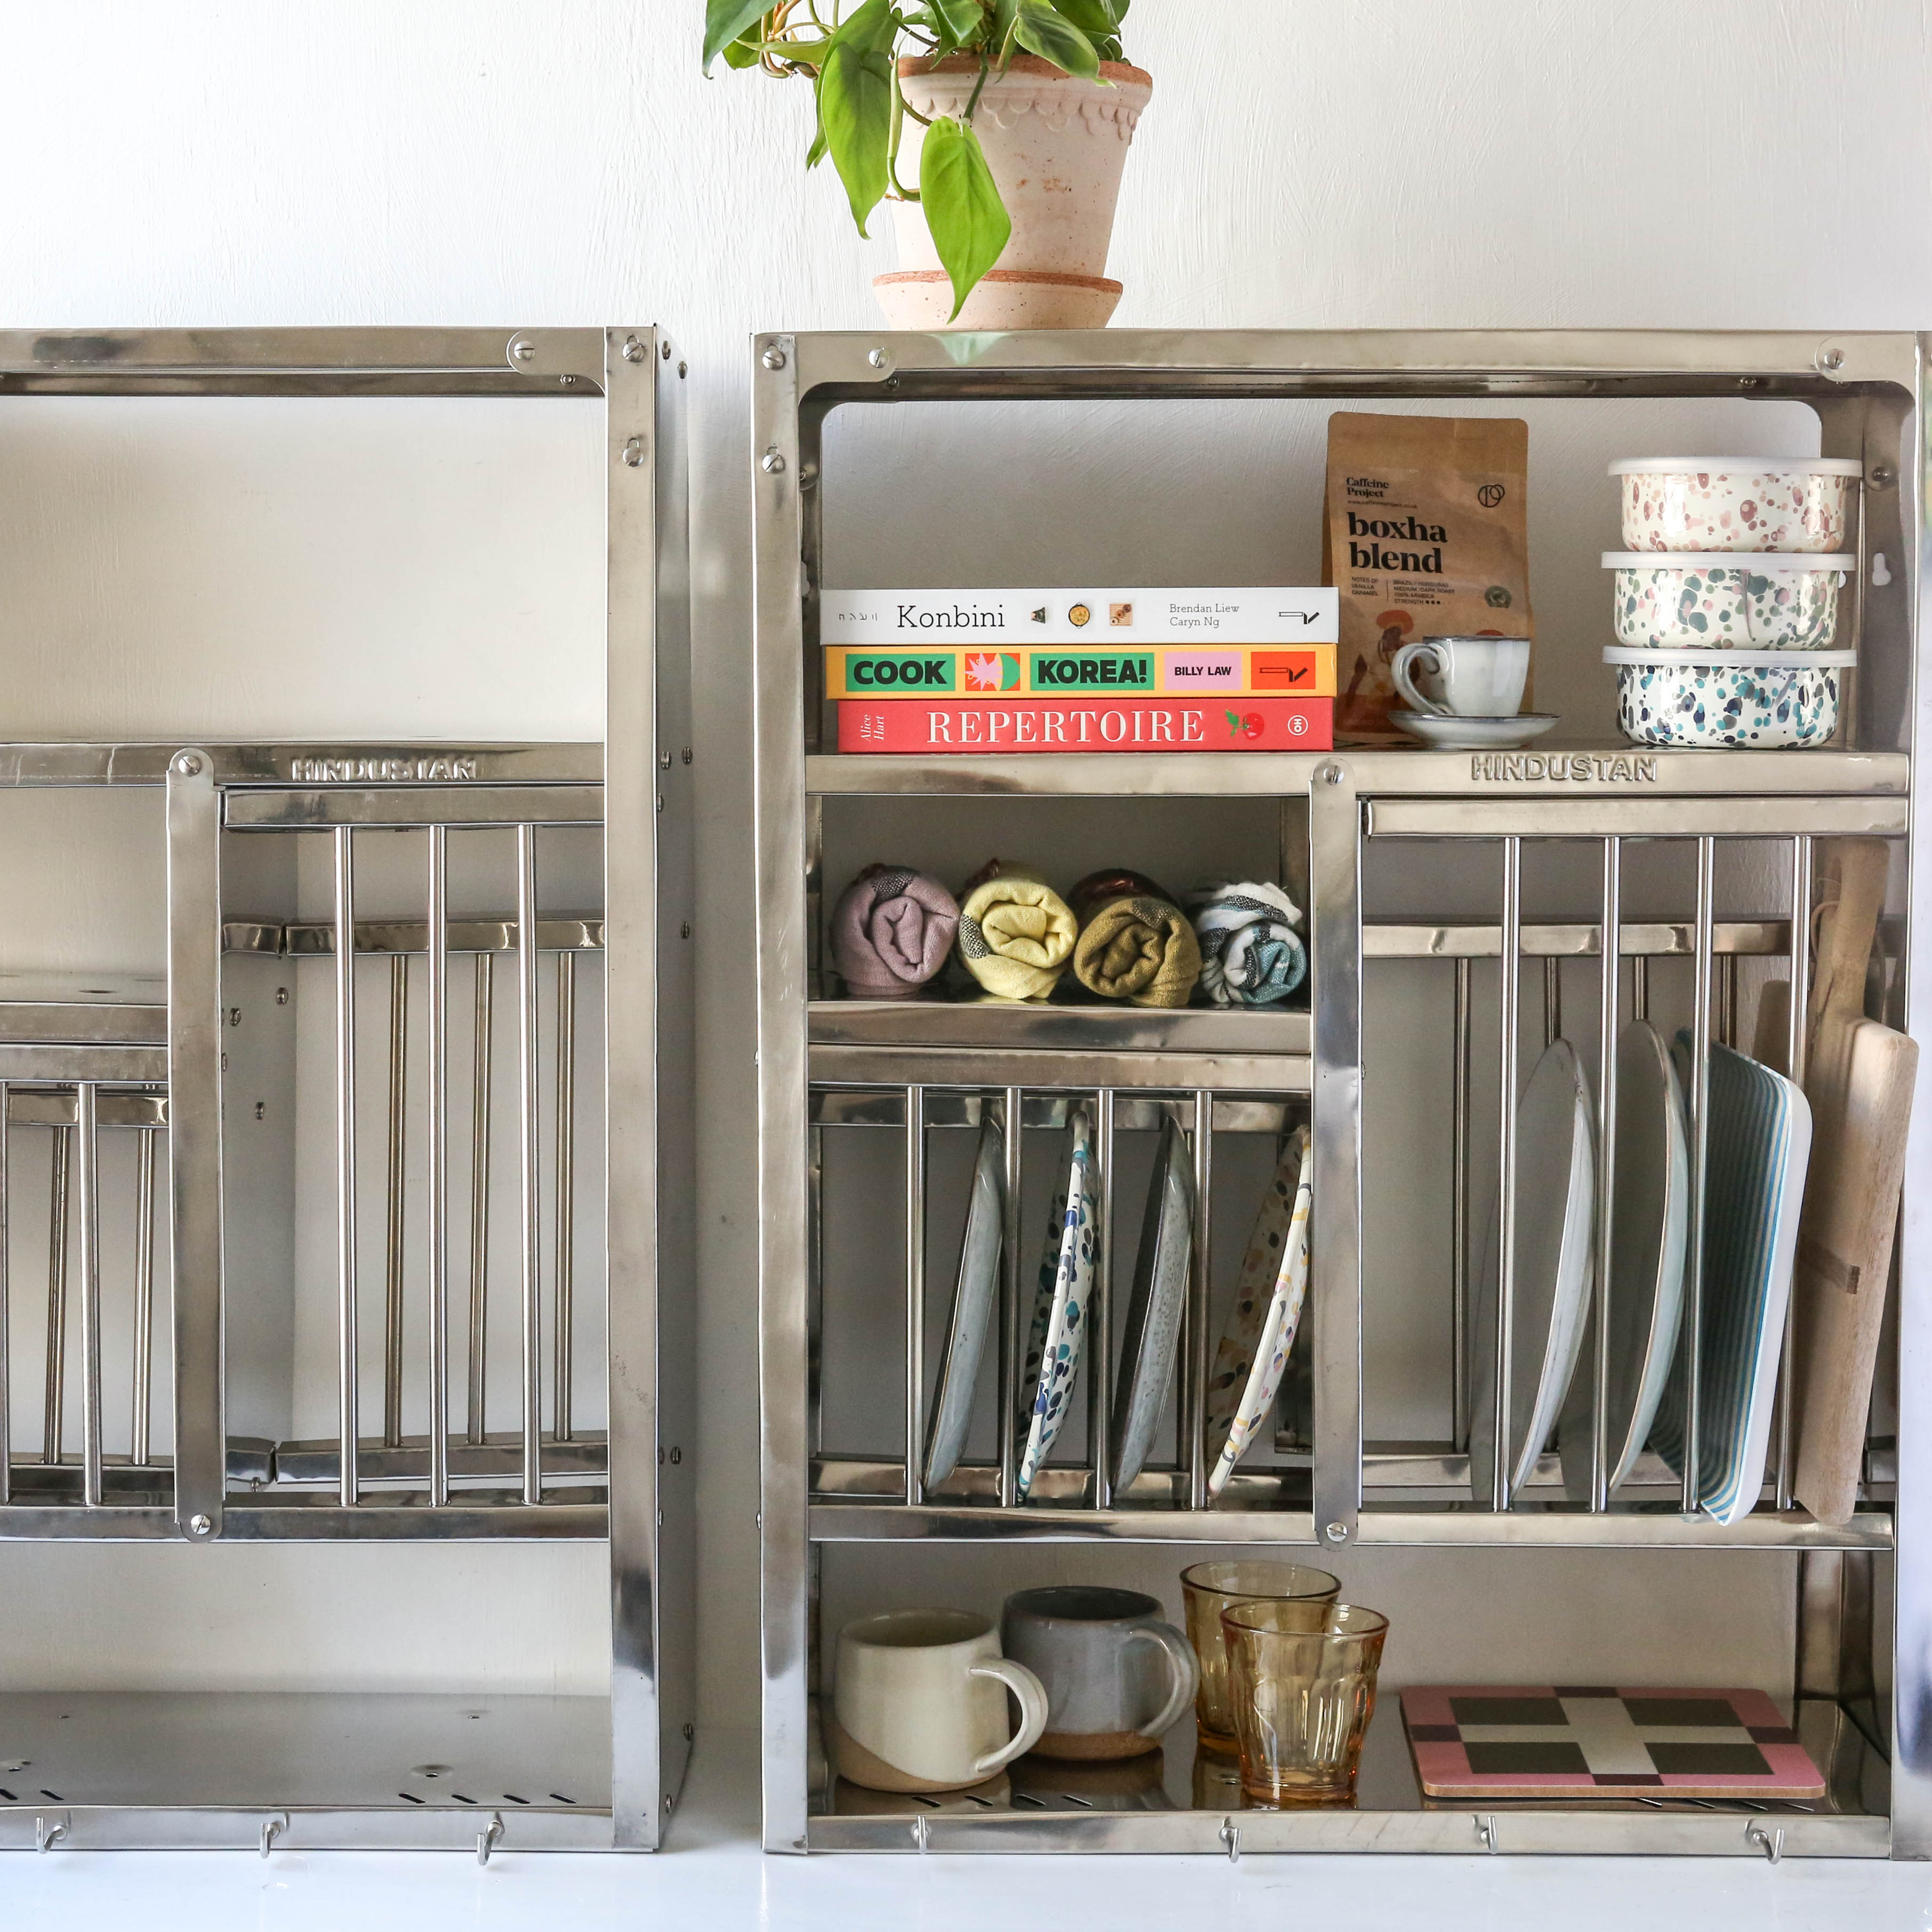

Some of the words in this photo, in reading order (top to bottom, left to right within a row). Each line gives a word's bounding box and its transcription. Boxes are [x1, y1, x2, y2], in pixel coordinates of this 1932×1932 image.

[1347, 477, 1389, 489] Caffeine
[1347, 487, 1383, 497] Project
[1347, 512, 1447, 543] boxha
[1349, 542, 1443, 574] blend
[897, 605, 1005, 628] Konbini
[1170, 603, 1212, 613] Brendan
[1215, 603, 1240, 613] Liew
[1170, 617, 1200, 629] Caryn
[1203, 616, 1219, 629] Ng
[853, 661, 947, 685] COOK
[1038, 659, 1147, 684] KOREA!
[1174, 666, 1204, 676] BILLY
[1207, 666, 1231, 675] LAW
[860, 714, 871, 742] Alice
[873, 716, 884, 740] Hart
[927, 711, 1204, 743] REPERTOIRE
[291, 756, 477, 781] HINDUSTAN
[1471, 754, 1656, 781] HINDUSTAN
